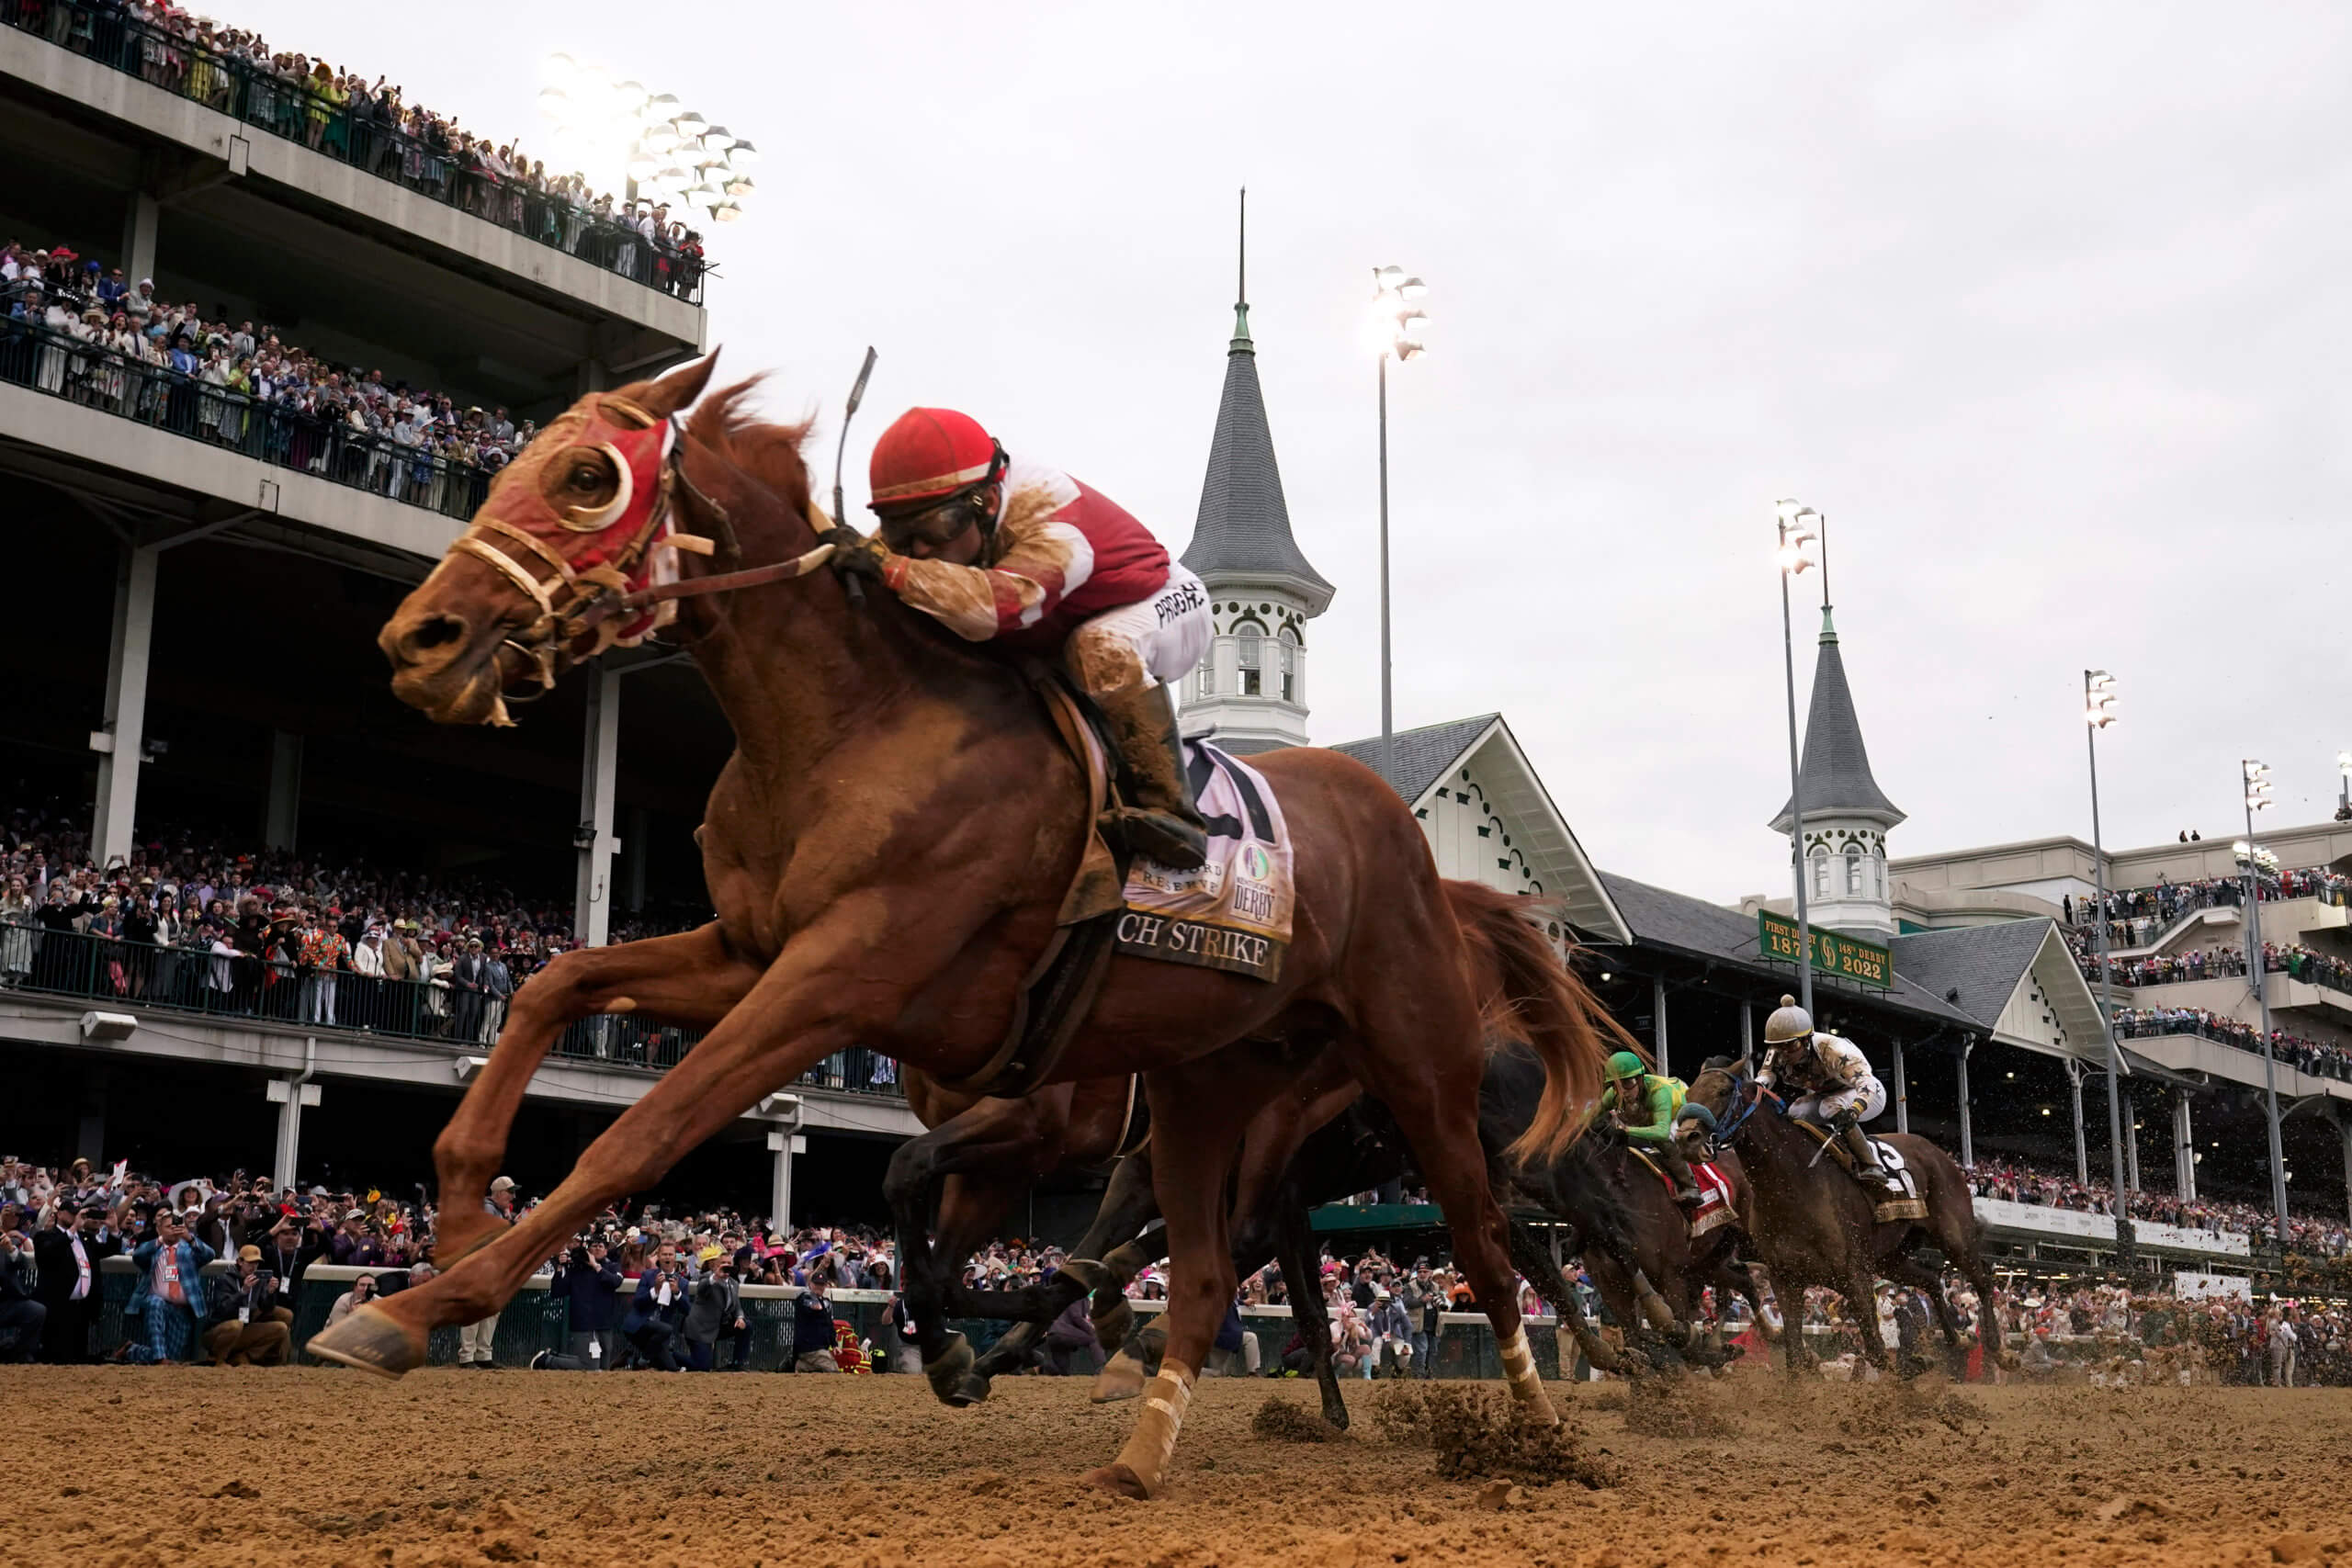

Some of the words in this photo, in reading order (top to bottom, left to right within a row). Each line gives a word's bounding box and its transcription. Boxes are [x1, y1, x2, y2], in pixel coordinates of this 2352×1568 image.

[1234, 885, 1275, 921] DERBY
[1765, 920, 1790, 937] FIRST
[1168, 921, 1269, 966] STRIKE
[1843, 955, 1882, 979] 2022
[1859, 948, 1885, 964] DERBY
